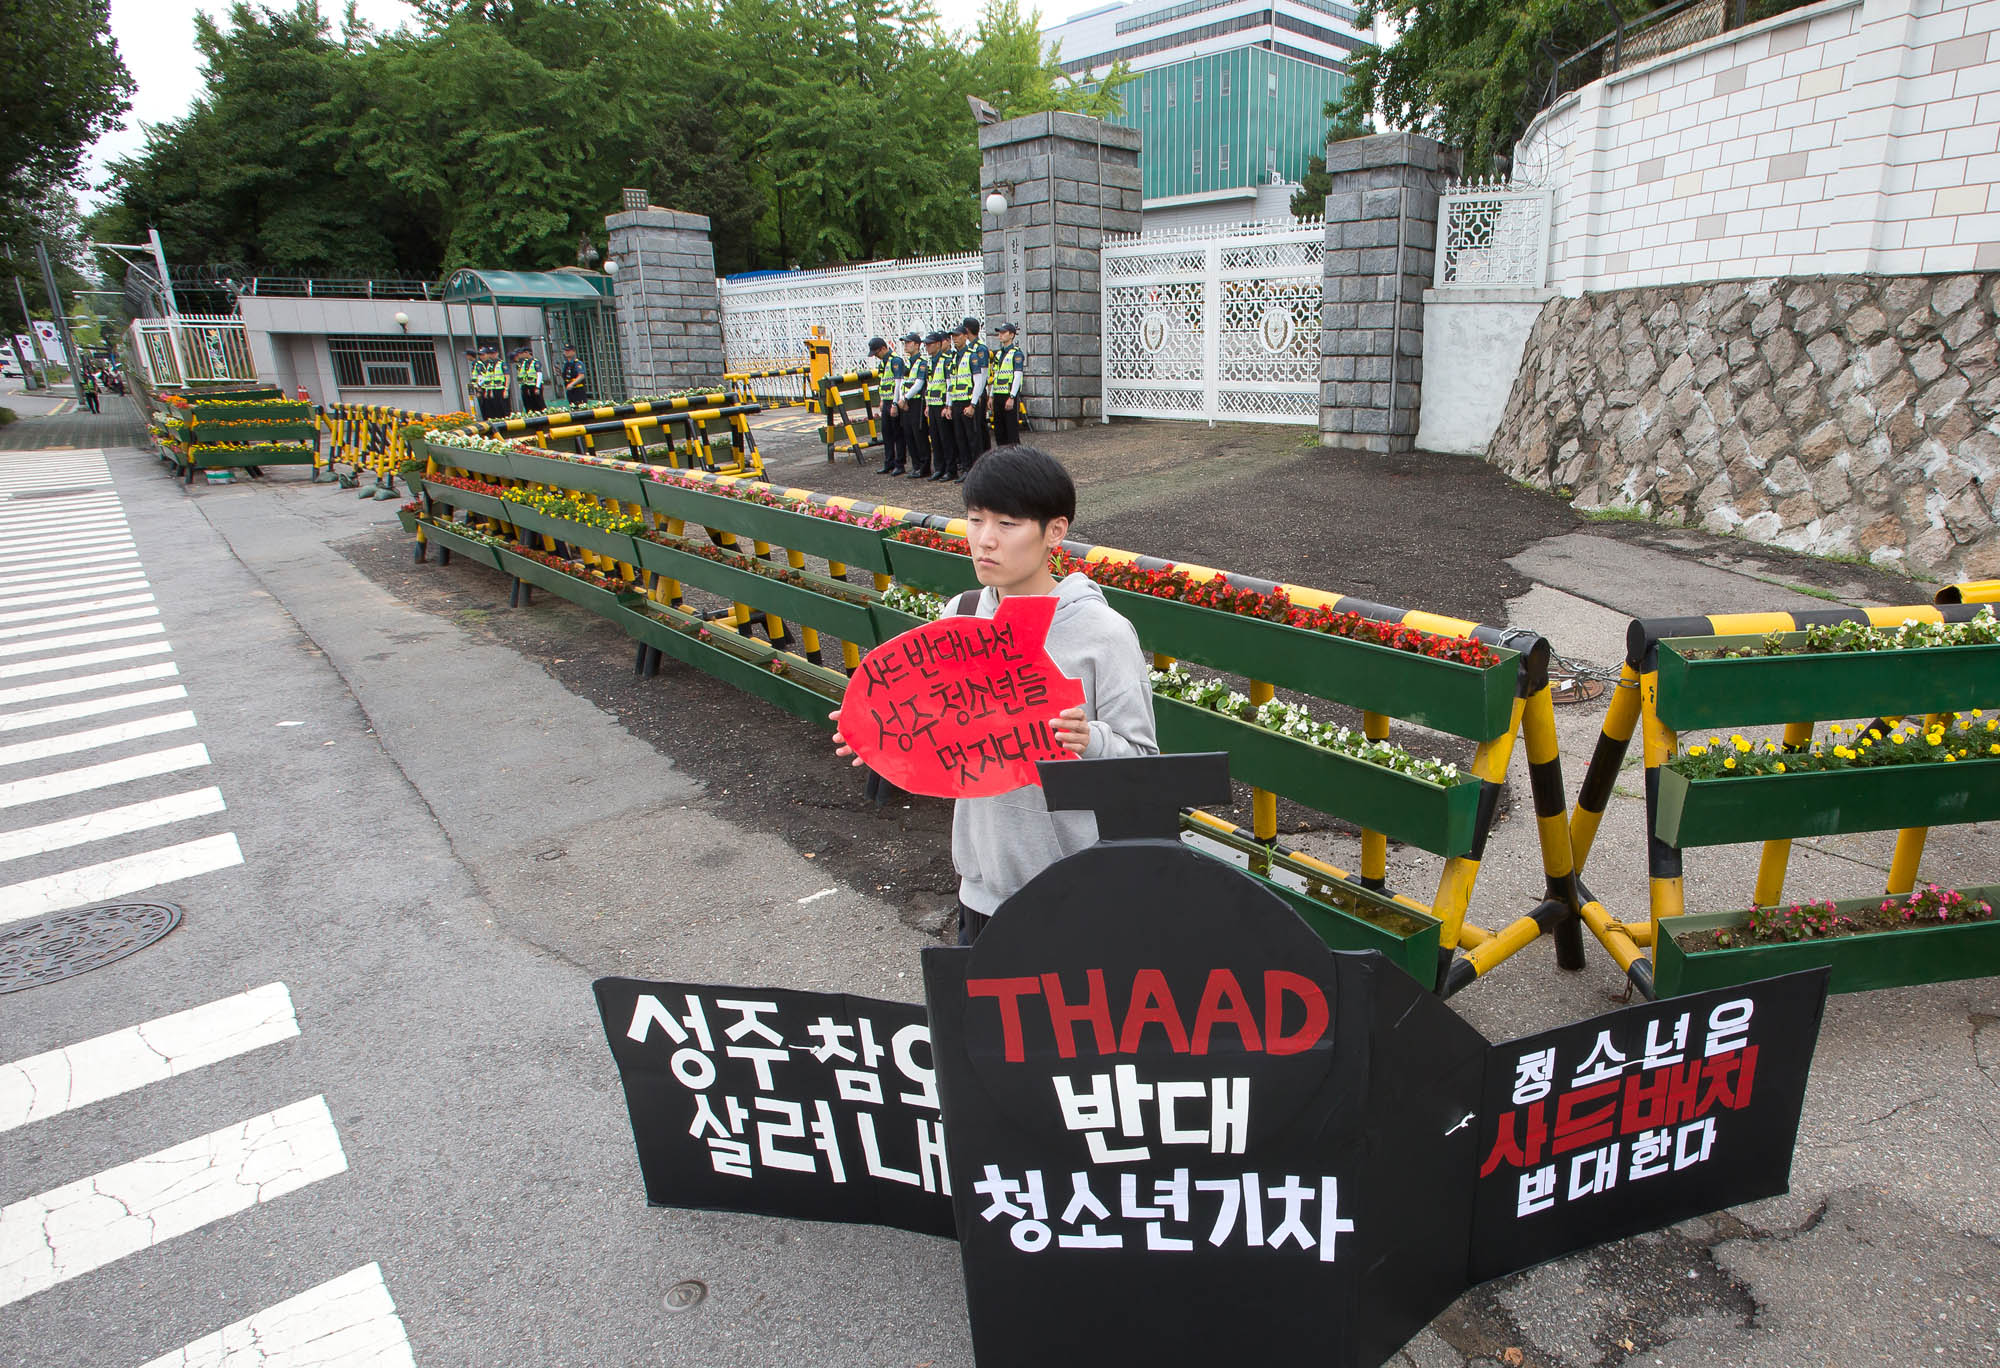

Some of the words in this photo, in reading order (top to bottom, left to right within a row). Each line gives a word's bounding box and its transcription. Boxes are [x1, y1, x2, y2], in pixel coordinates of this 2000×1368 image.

[871, 694, 940, 752] 성주
[929, 663, 1049, 726] 청소년들
[626, 993, 790, 1091] 성주
[966, 968, 1330, 1063] THAAD
[1512, 998, 1755, 1105] 청소년은
[1051, 1064, 1251, 1164] 반대
[1480, 1044, 1760, 1179] 사드배치
[973, 1163, 1355, 1262] 청소년기차
[1516, 1116, 1717, 1219] 반대한다
